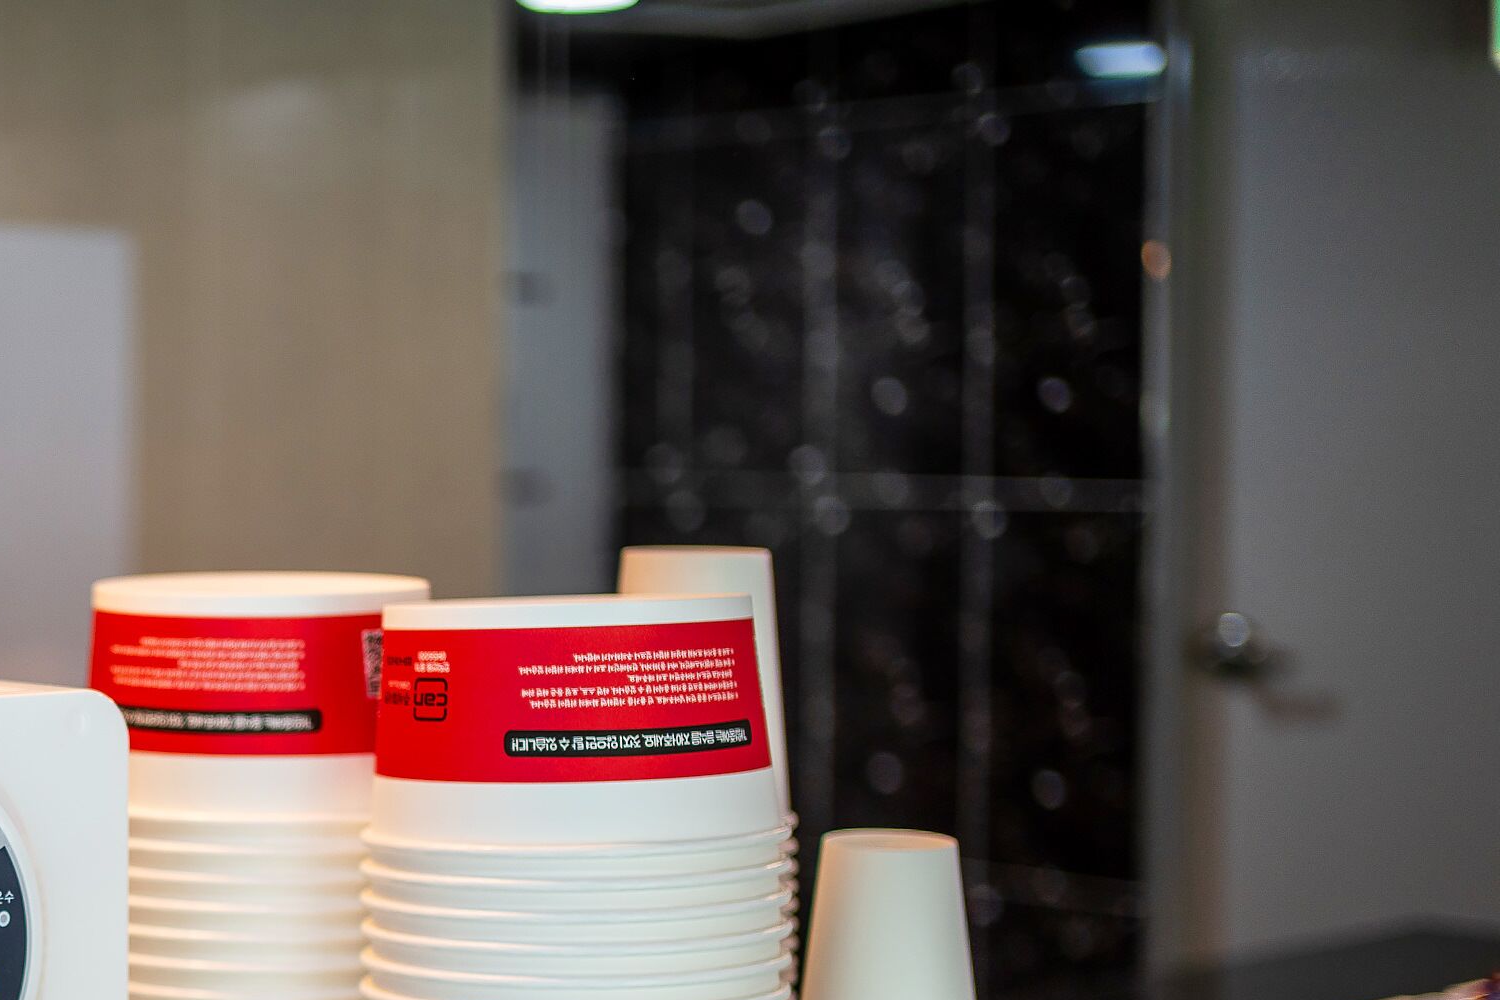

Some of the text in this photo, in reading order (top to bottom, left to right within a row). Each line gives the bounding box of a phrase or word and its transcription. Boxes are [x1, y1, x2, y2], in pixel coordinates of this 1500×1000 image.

[413, 692, 447, 707] can
[511, 736, 558, 752] 있습니다!
[558, 736, 570, 751] 수
[571, 736, 584, 750] 탈
[586, 735, 618, 750] 않으면
[619, 734, 641, 749] 젓지
[691, 730, 714, 745] 음식을
